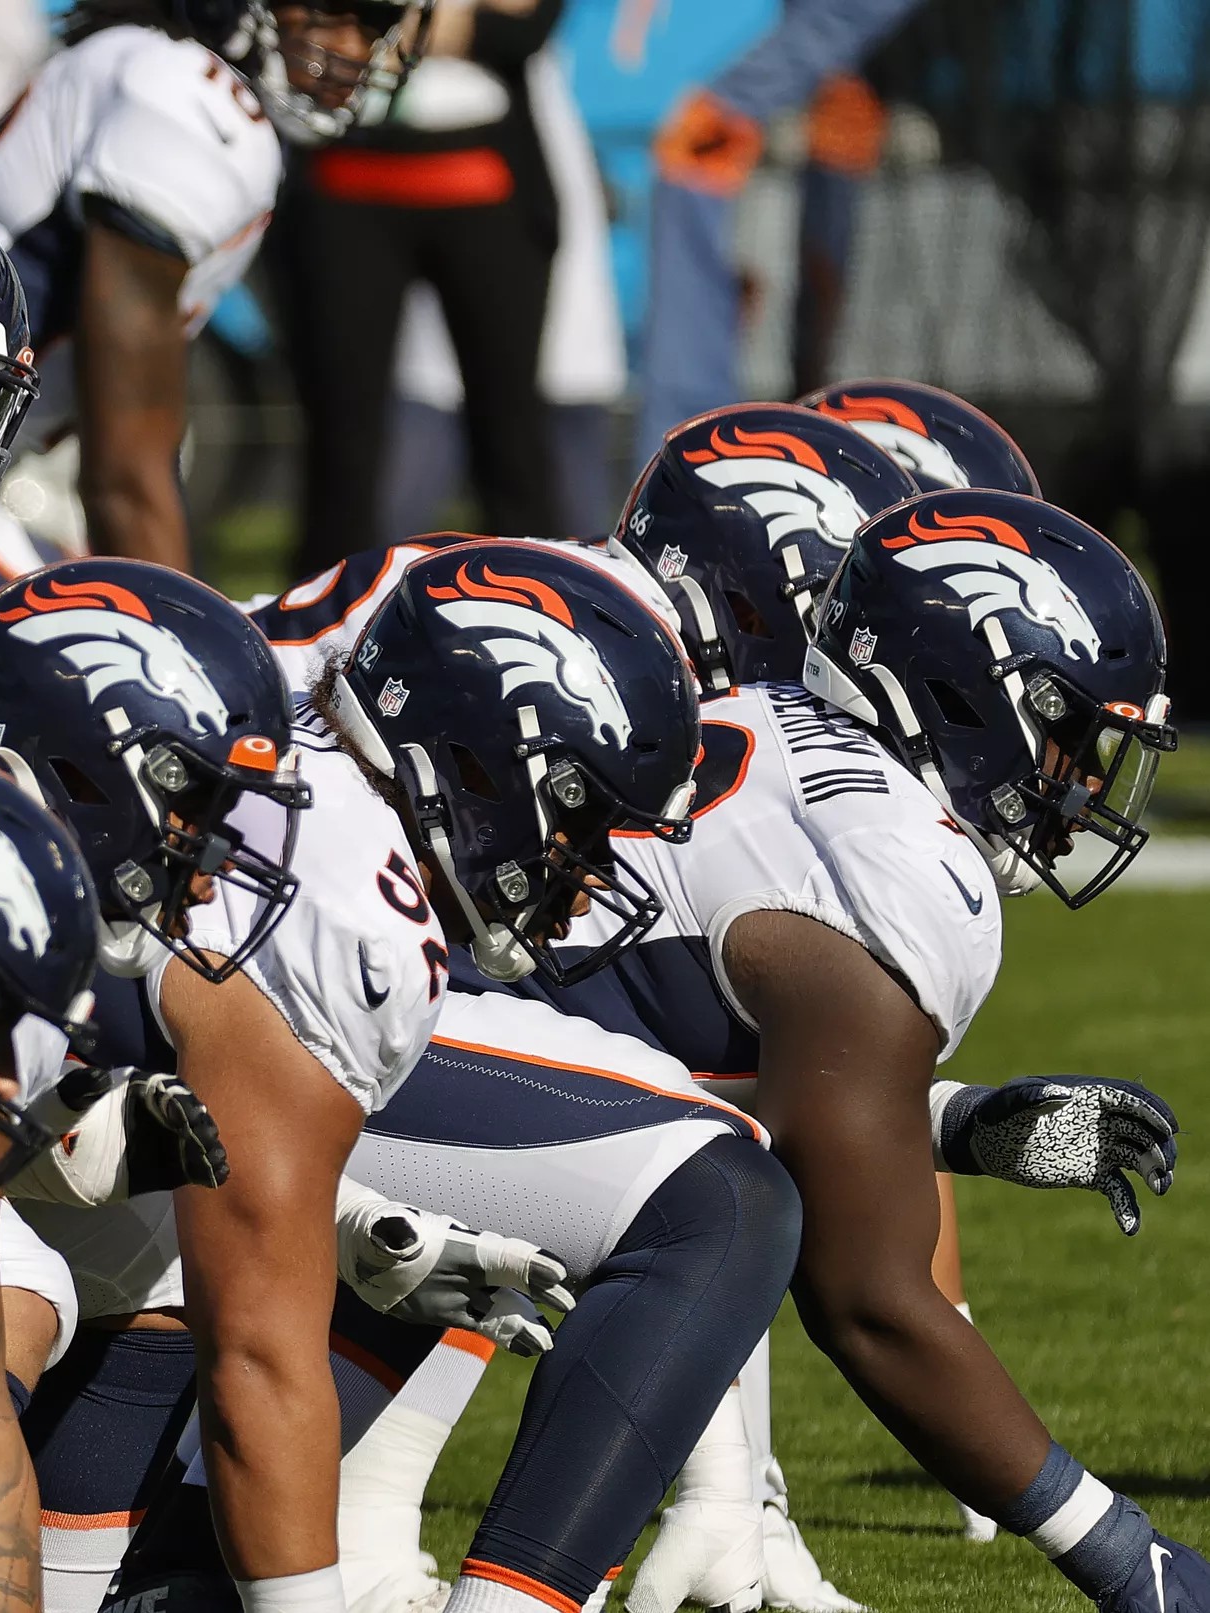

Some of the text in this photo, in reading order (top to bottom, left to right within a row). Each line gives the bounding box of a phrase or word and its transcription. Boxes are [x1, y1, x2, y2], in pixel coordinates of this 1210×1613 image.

[630, 508, 650, 536] 66
[826, 599, 844, 625] 79
[358, 638, 379, 670] 52
[852, 641, 870, 660] NFL
[381, 692, 400, 712] NFL
